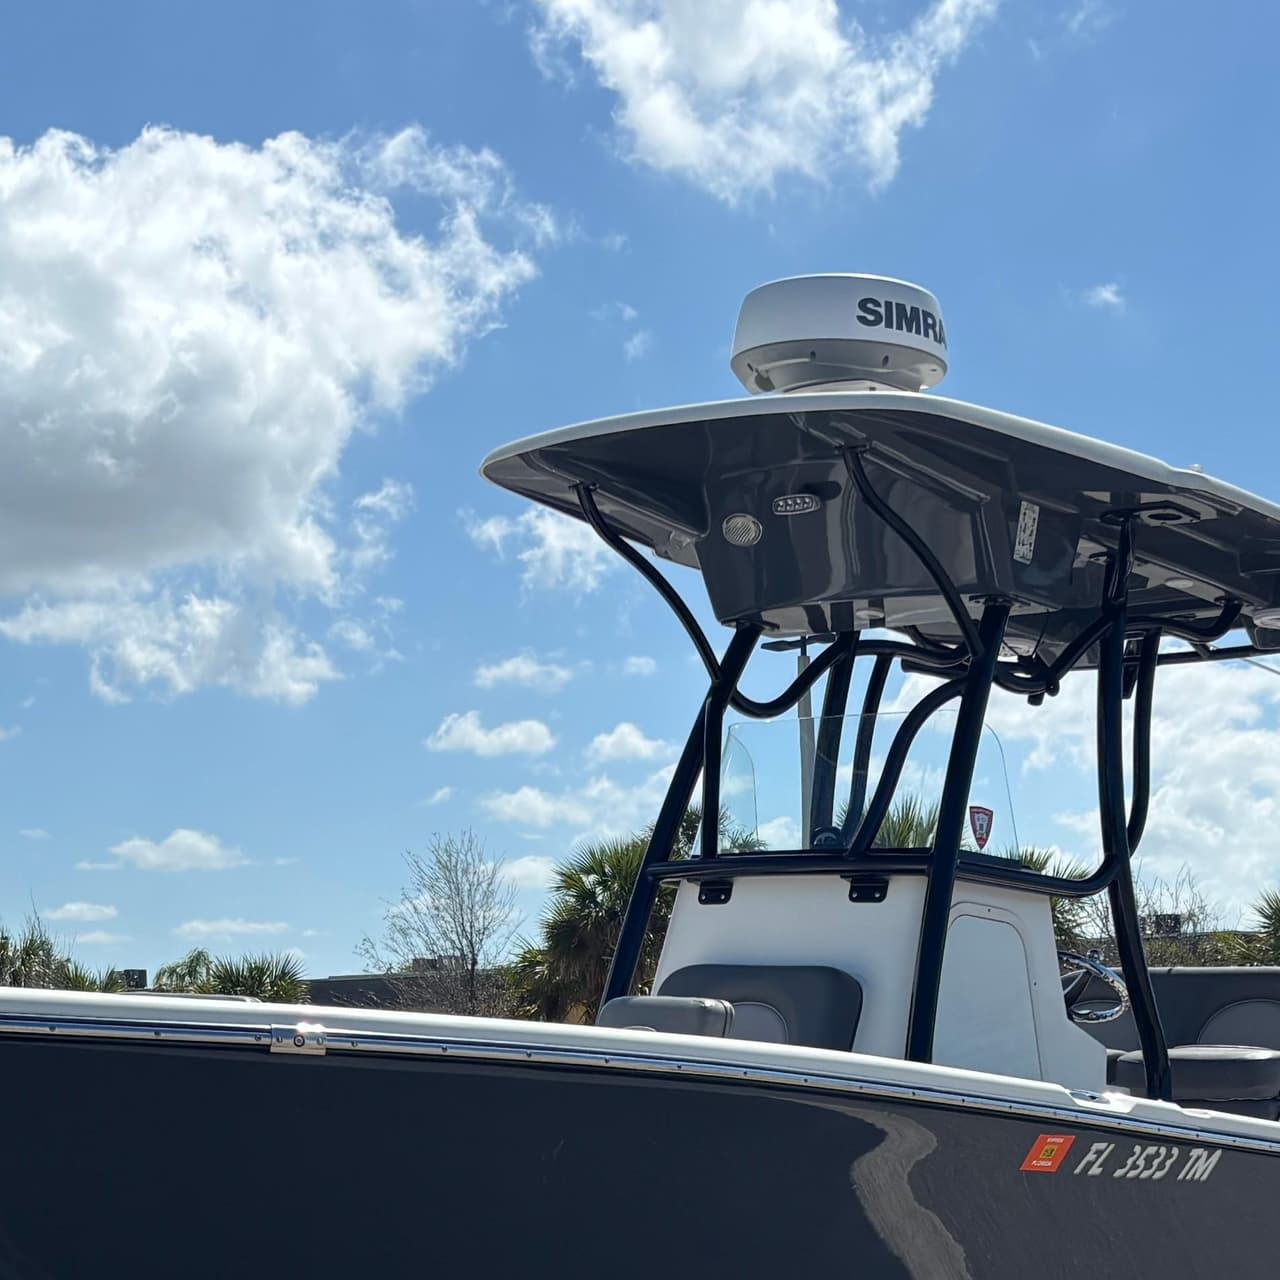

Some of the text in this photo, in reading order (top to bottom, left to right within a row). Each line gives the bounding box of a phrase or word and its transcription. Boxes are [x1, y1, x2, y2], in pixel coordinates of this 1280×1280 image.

[1073, 1143, 1222, 1181] FL 3533 TM
